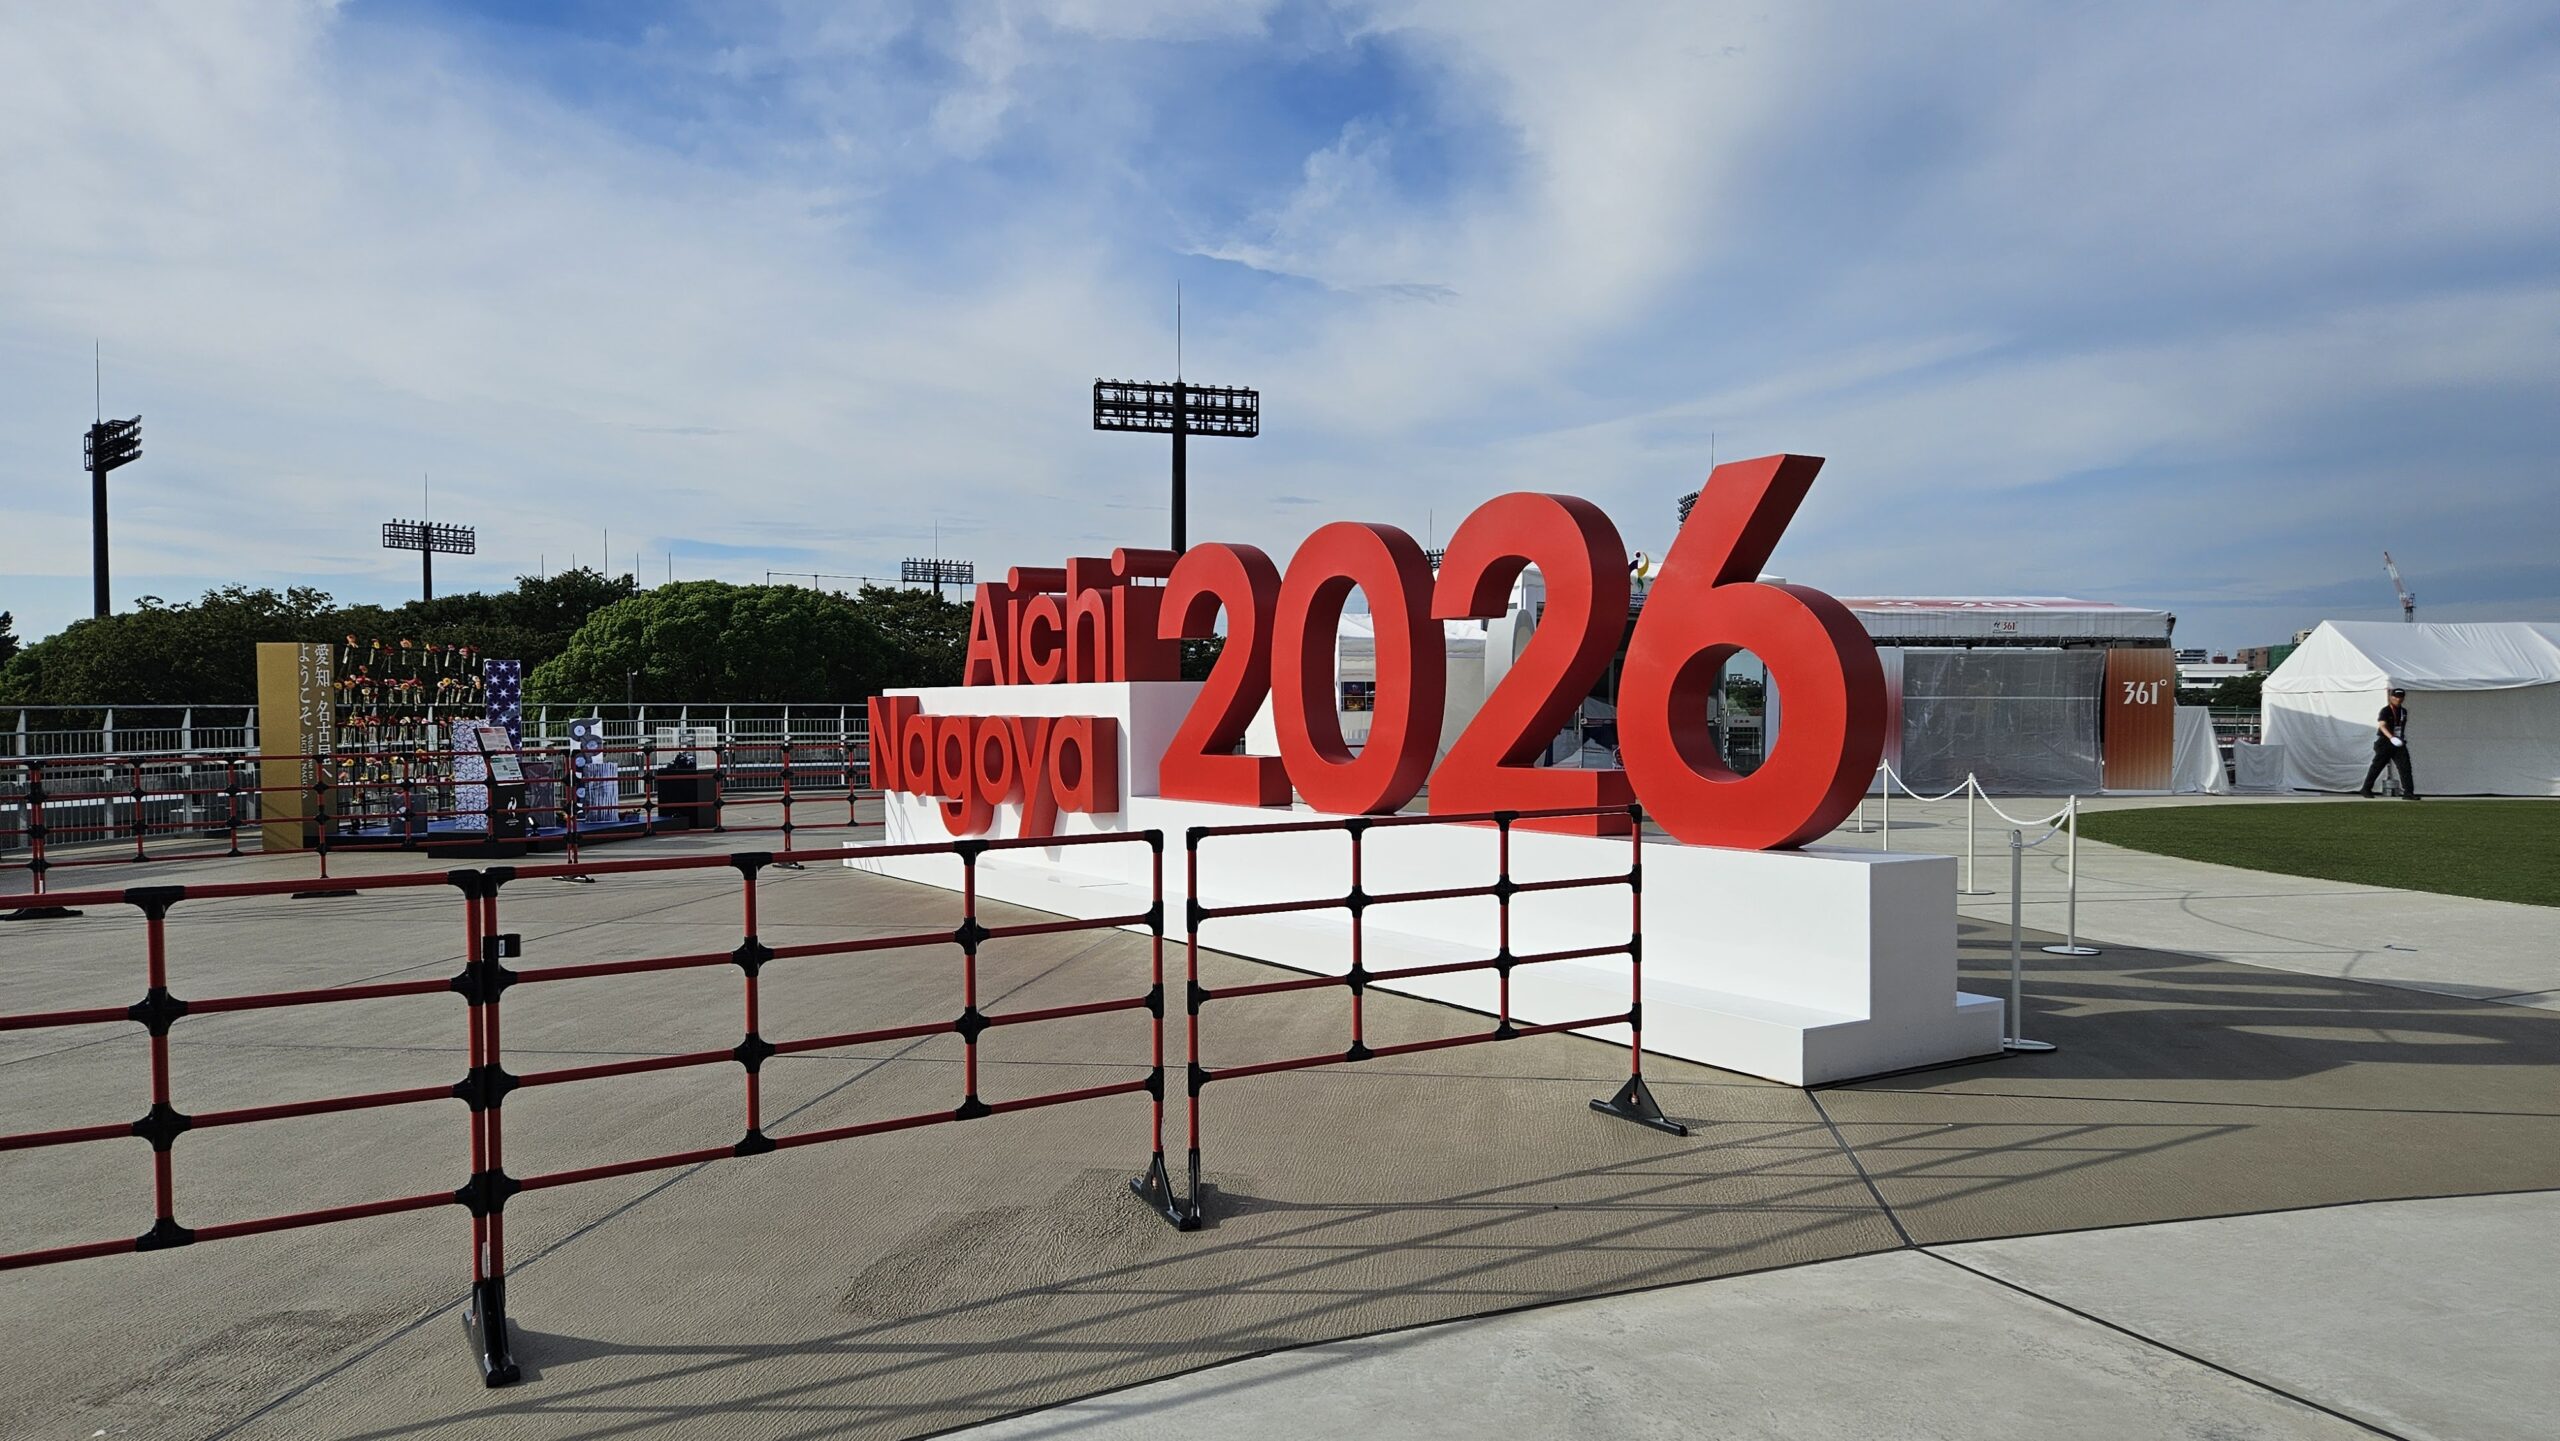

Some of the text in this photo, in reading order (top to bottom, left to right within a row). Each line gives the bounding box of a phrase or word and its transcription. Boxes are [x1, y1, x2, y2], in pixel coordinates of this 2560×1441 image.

[299, 642, 312, 727] ようこそ
[963, 547, 1132, 686] Aichi
[1158, 453, 1886, 850] 2026
[868, 696, 1112, 838] Nagoya
